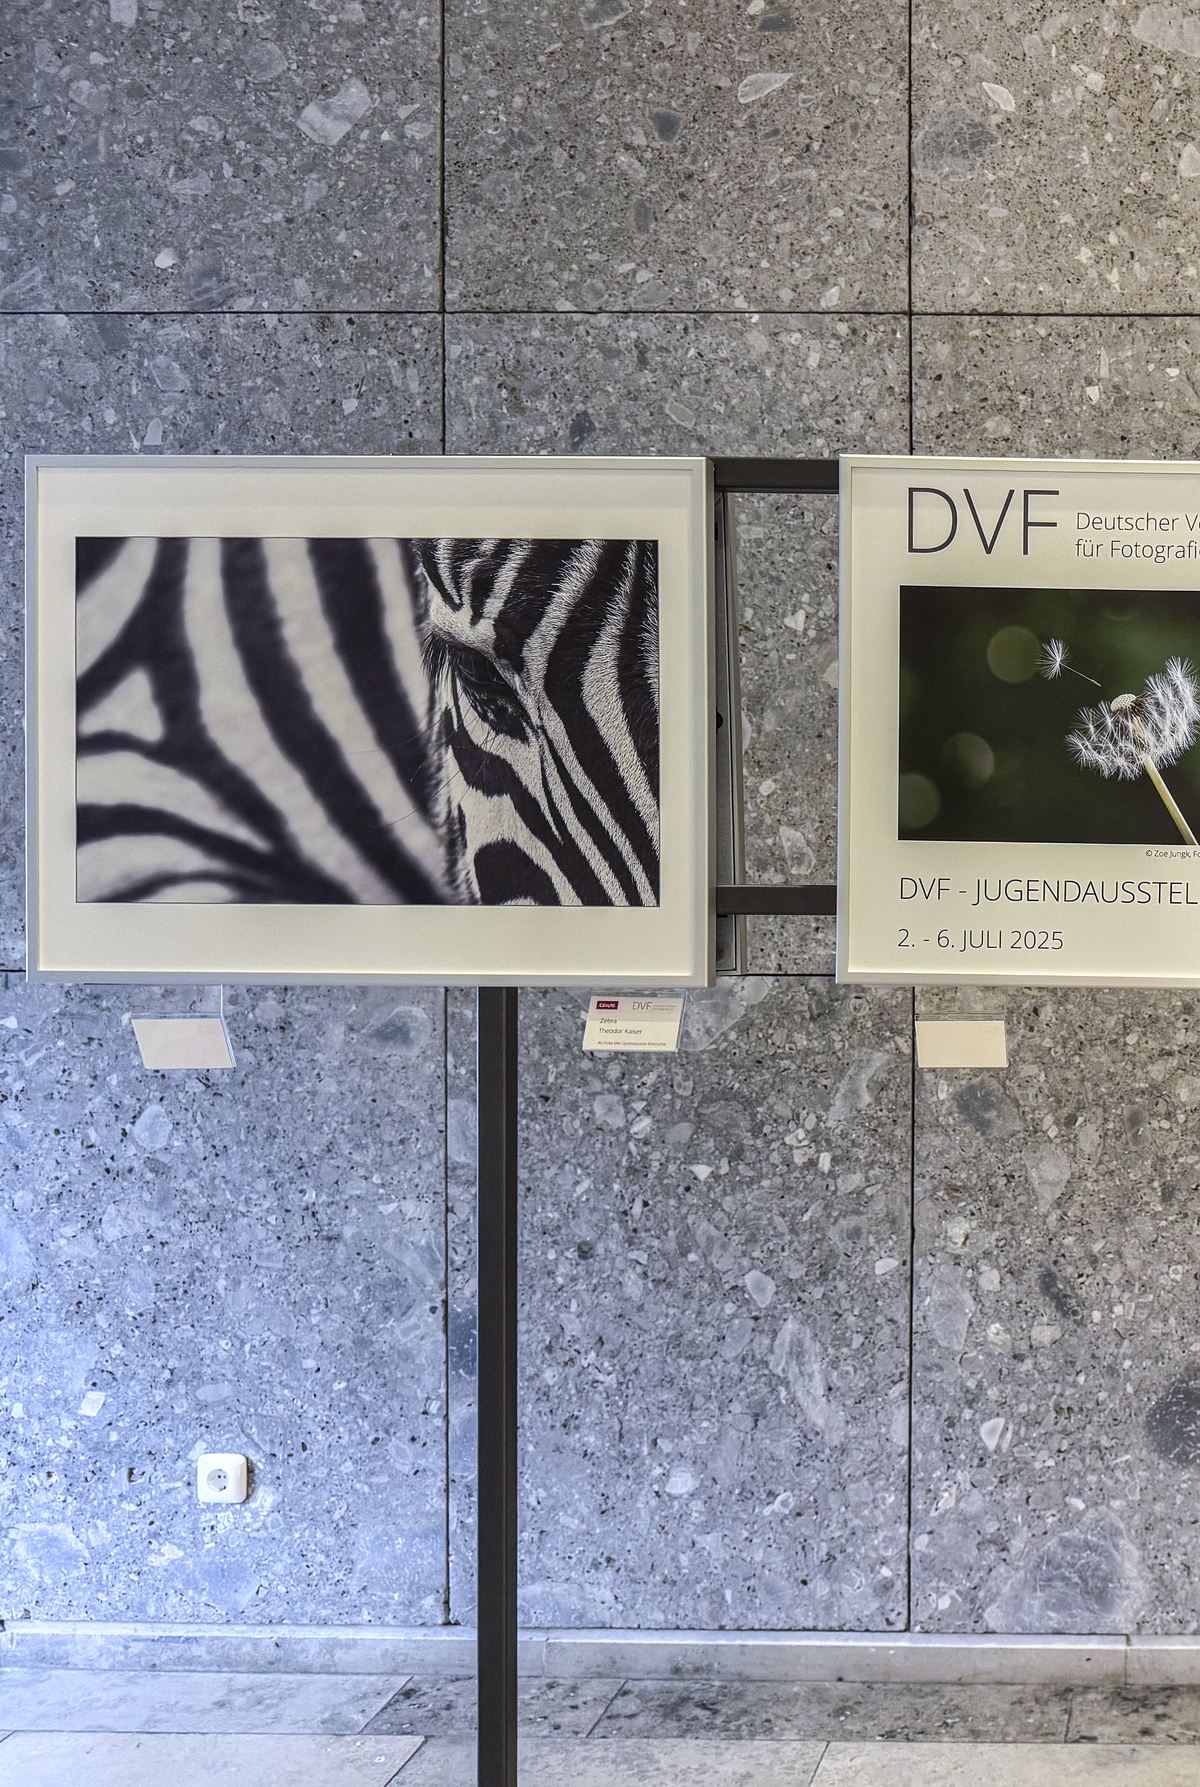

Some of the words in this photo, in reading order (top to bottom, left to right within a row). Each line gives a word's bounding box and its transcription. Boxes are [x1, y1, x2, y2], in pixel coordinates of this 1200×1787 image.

[907, 486, 1060, 556] DVF
[1076, 512, 1179, 532] Deutscher
[1075, 539, 1104, 558] für
[900, 877, 951, 900] DVF
[897, 928, 916, 948] 2.
[936, 929, 955, 949] 6.
[959, 929, 1003, 953] JULI
[1010, 930, 1064, 950] 2025
[632, 1001, 652, 1010] DVF
